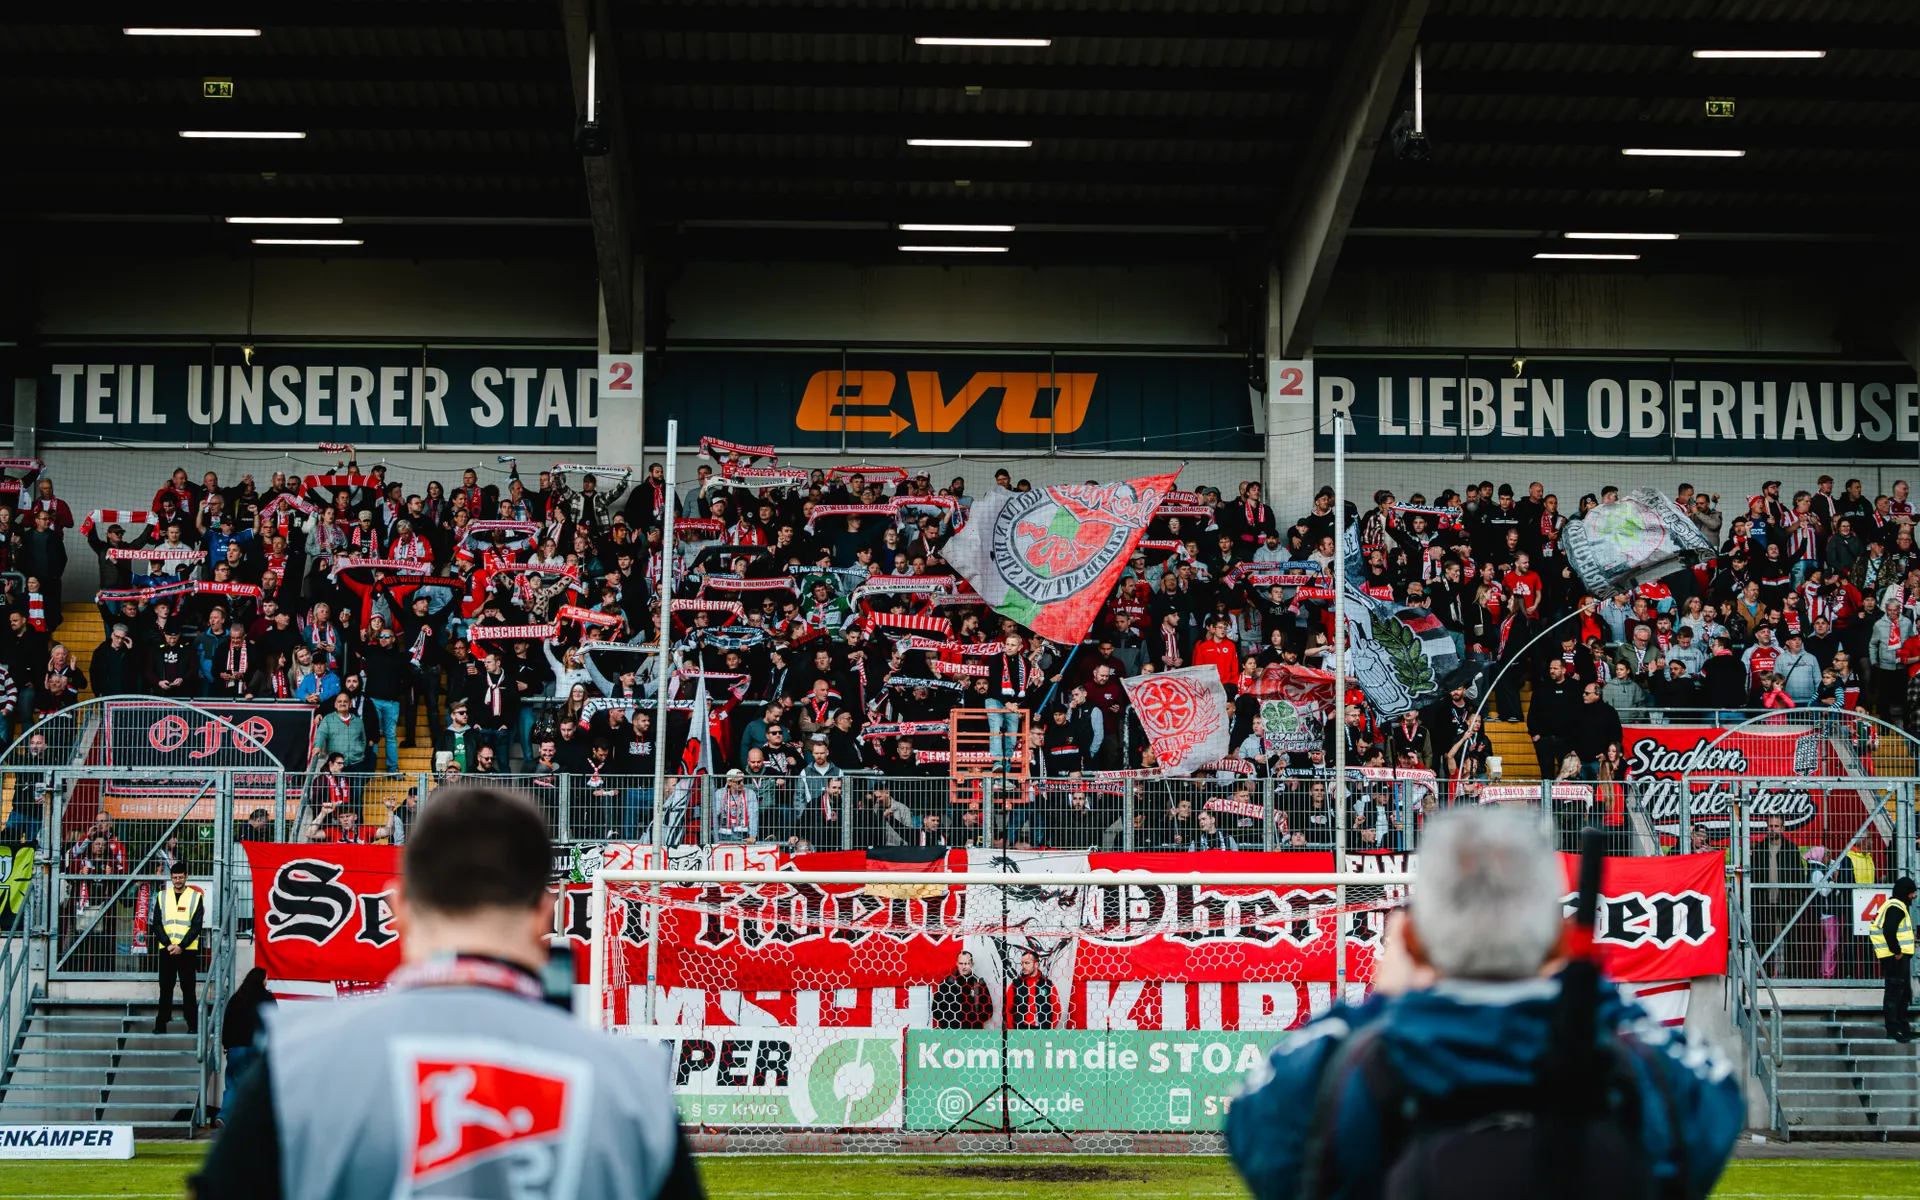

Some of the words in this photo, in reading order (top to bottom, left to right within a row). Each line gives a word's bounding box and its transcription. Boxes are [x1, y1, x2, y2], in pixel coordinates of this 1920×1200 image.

[609, 362, 633, 391] 2
[1280, 367, 1303, 395] 2
[52, 364, 167, 424] TEIL
[187, 365, 450, 427] UNSERER
[1379, 376, 1565, 438] LIEBEN
[1586, 378, 1919, 443] OBERHAUSE
[1861, 894, 1886, 921] 4
[919, 1043, 1030, 1069] Komm
[1045, 1043, 1078, 1069] in
[1084, 1042, 1139, 1070] die
[708, 1104, 727, 1115] 57
[733, 1104, 779, 1116] KrWG
[985, 1093, 1085, 1117] stoag.de
